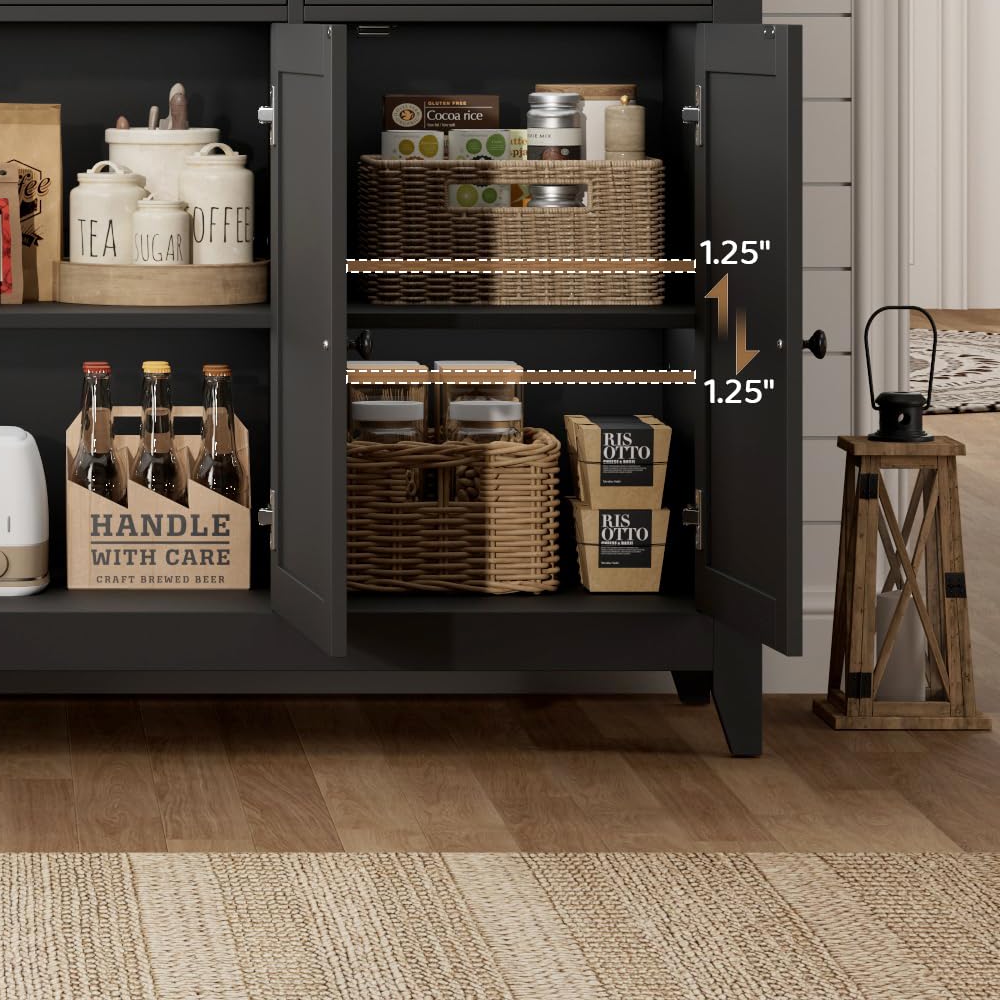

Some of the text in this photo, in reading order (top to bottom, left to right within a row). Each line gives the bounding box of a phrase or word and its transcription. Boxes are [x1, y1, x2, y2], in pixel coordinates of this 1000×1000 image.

[426, 109, 461, 121] Cocoa
[463, 109, 483, 121] rice
[77, 219, 117, 258] TEA
[134, 232, 184, 262] SUGAR
[603, 432, 633, 446] RIS
[603, 446, 651, 460] OTTO
[90, 514, 231, 537] HANDLE
[602, 514, 631, 528] RIS
[601, 527, 649, 541] OTTO
[91, 549, 231, 566] WITH CARE
[96, 575, 225, 584] CRAFT BREWED BEER
